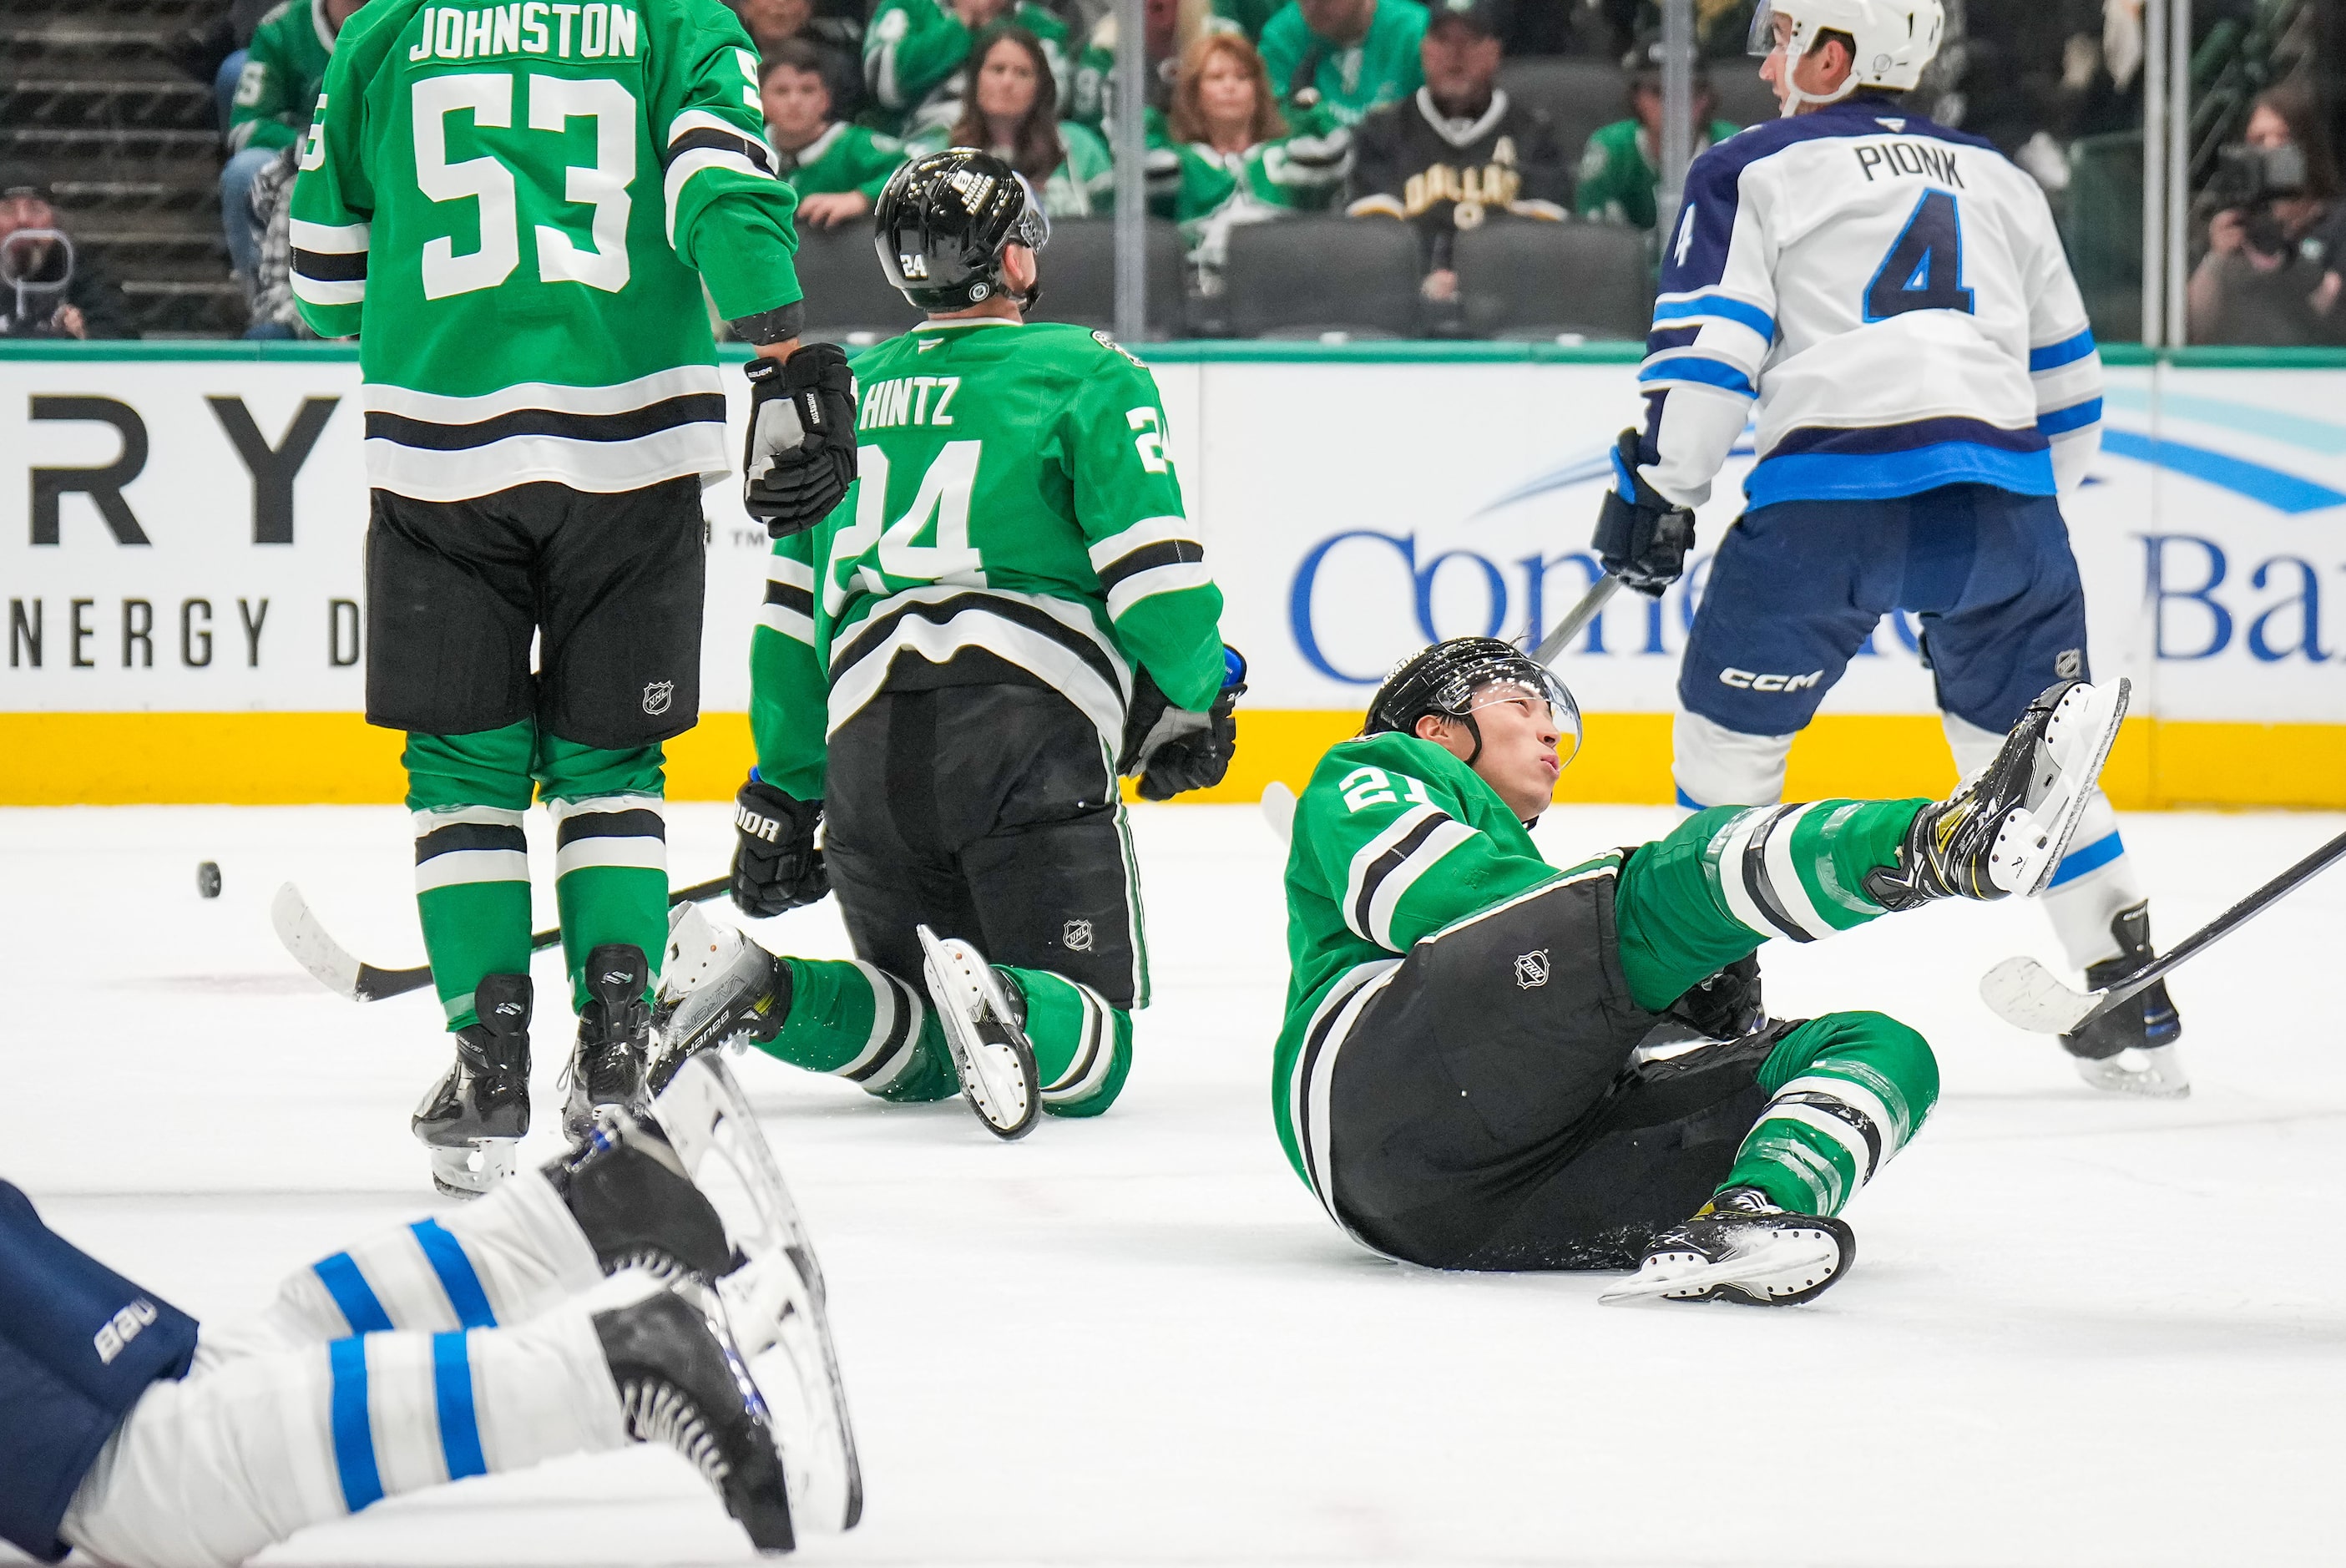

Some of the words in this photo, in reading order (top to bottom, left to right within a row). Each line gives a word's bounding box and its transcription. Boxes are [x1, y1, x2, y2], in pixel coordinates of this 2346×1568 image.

[409, 2, 636, 62] JOHNSTON
[412, 73, 637, 301] 53
[961, 172, 984, 205] ENERGY
[1853, 143, 1964, 190] PIONK
[966, 175, 996, 215] TRANSFER
[1673, 201, 1696, 268] 4
[1863, 187, 1974, 324] 4
[899, 254, 929, 278] 24
[806, 392, 821, 425] JOHNSTON
[859, 377, 961, 430] HINTZ
[822, 440, 988, 618] 24
[9, 597, 270, 669] NERGY
[1719, 667, 1824, 693] CCM
[1338, 766, 1430, 814] 21
